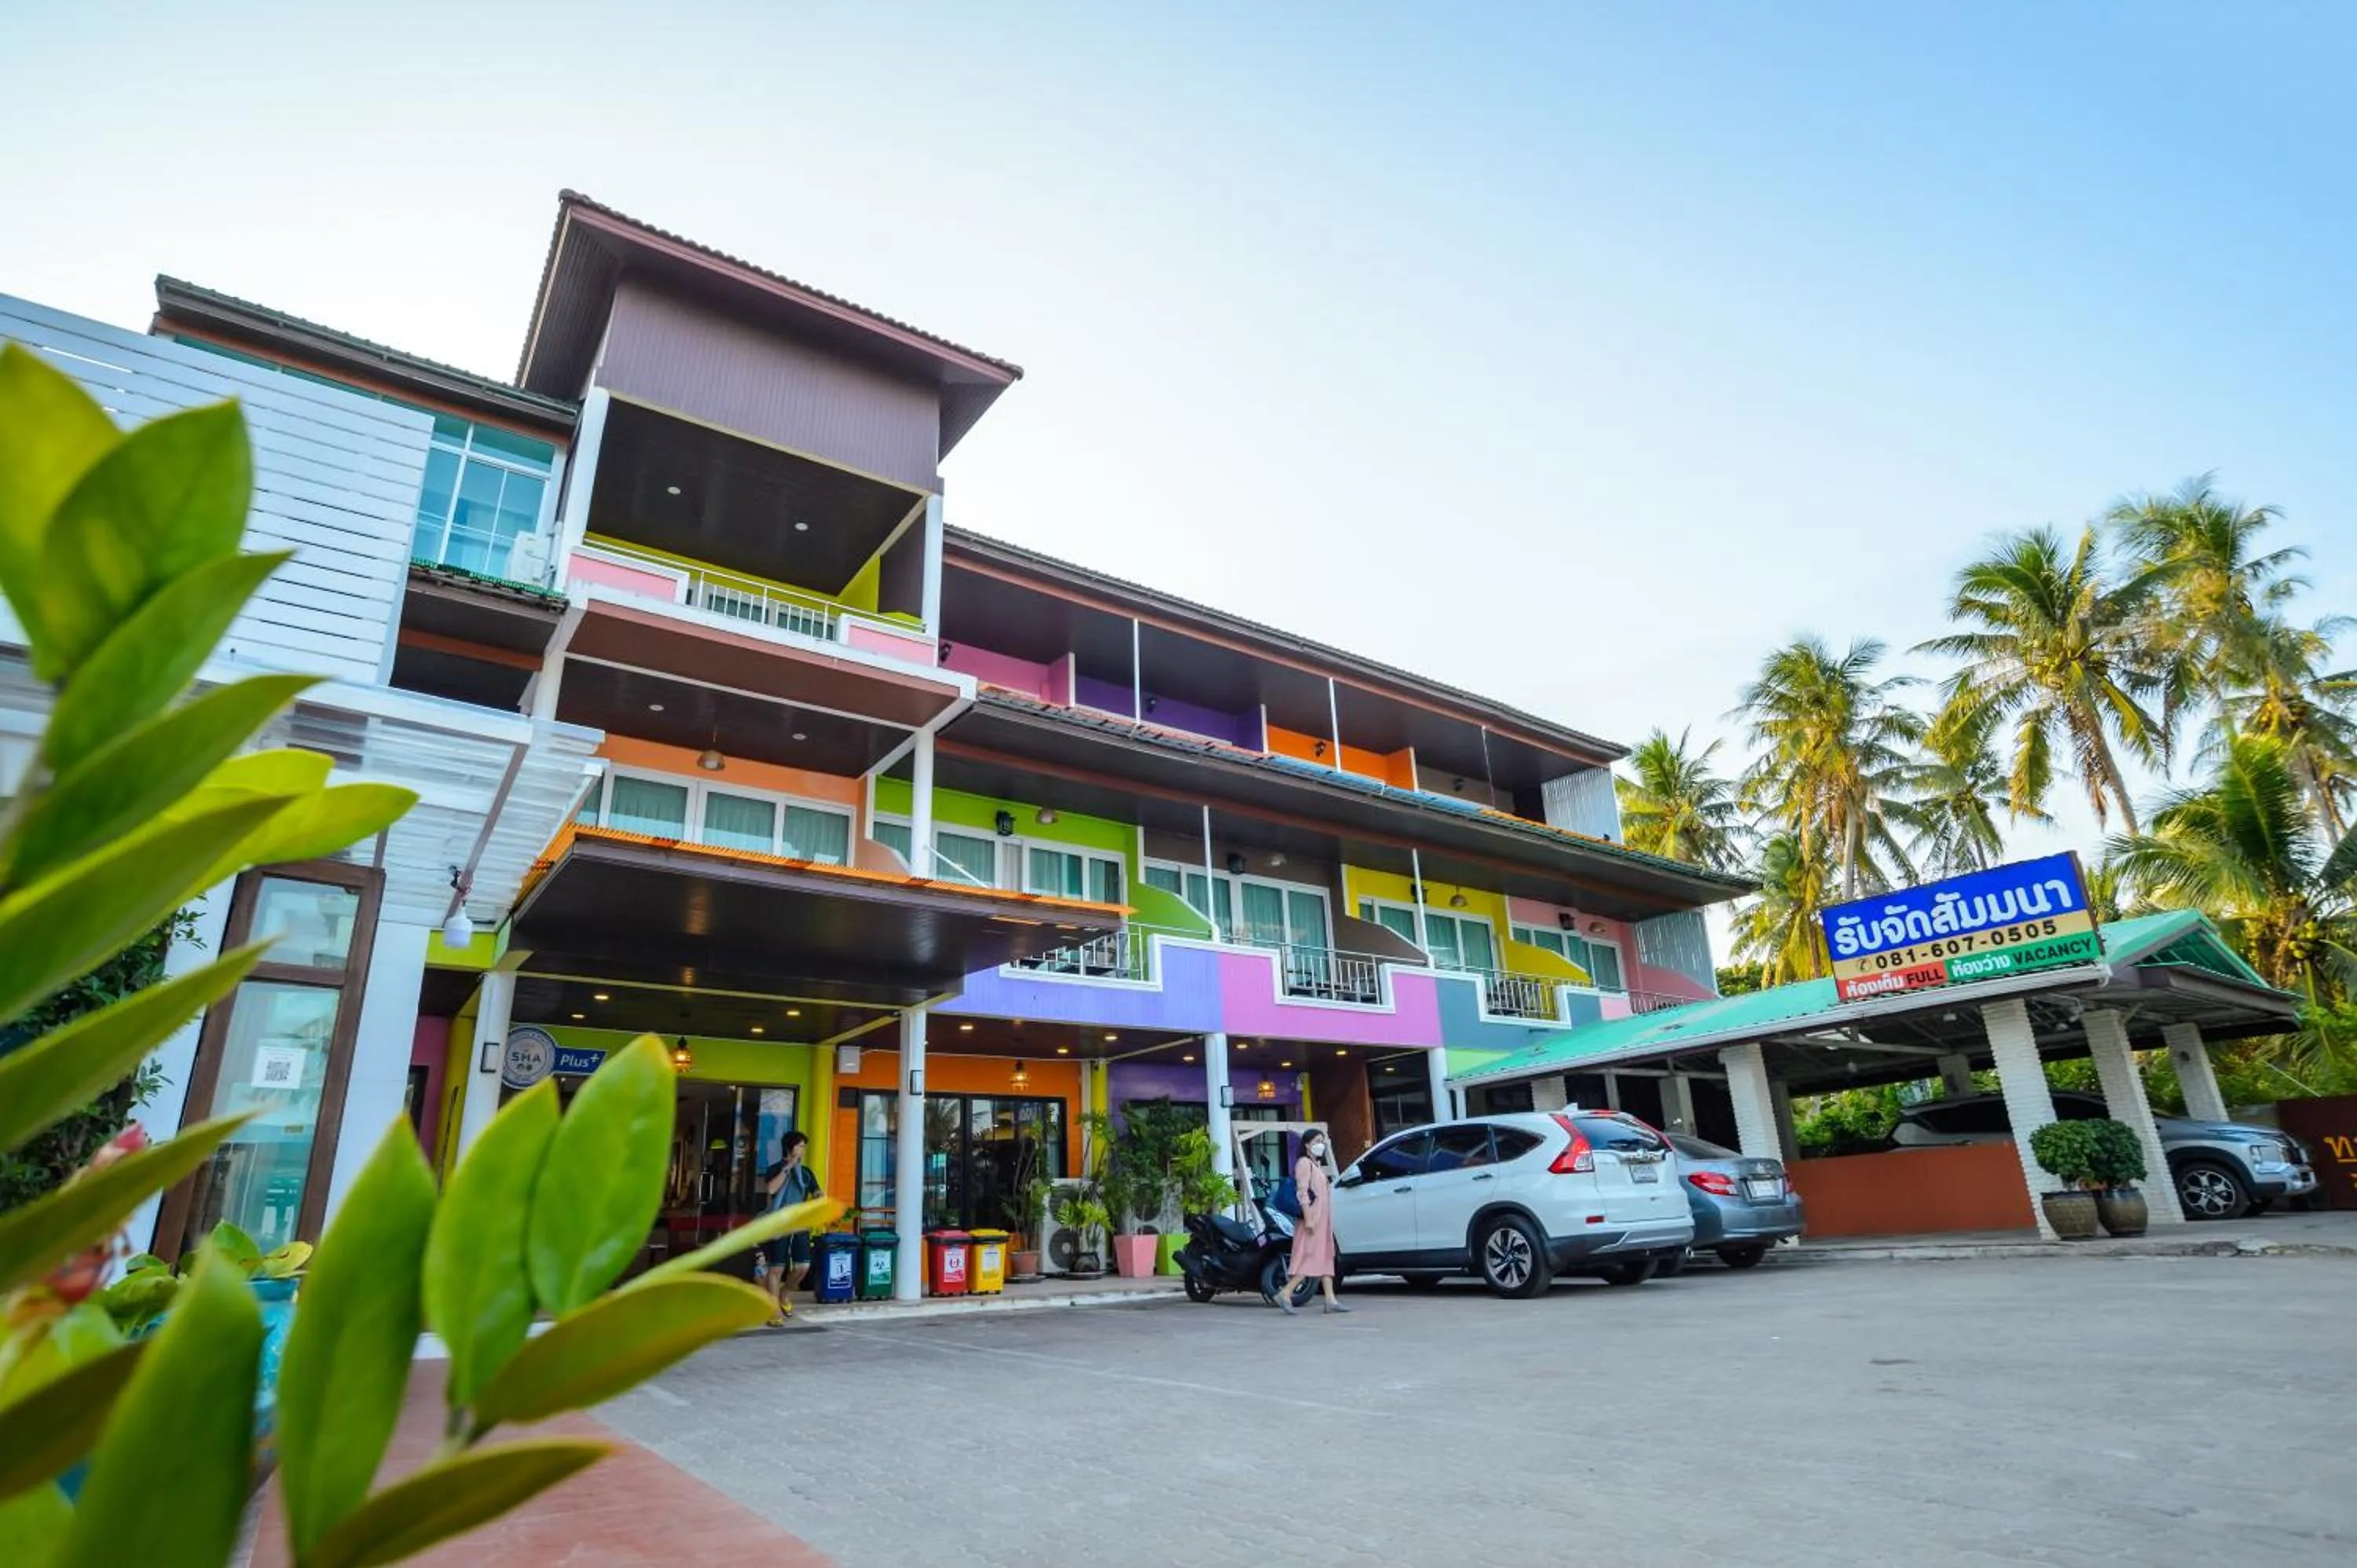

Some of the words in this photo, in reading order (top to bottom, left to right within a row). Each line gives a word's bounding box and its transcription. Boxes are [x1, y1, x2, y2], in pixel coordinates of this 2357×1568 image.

[1835, 878, 2073, 955] รับจัดสัมมนา
[1876, 919, 2056, 969] 081-607-0505
[1952, 954, 2011, 977] ห้องว่าง
[2012, 937, 2093, 965] VACANCY
[1907, 968, 1943, 984] FULL
[511, 1053, 541, 1063] SHA
